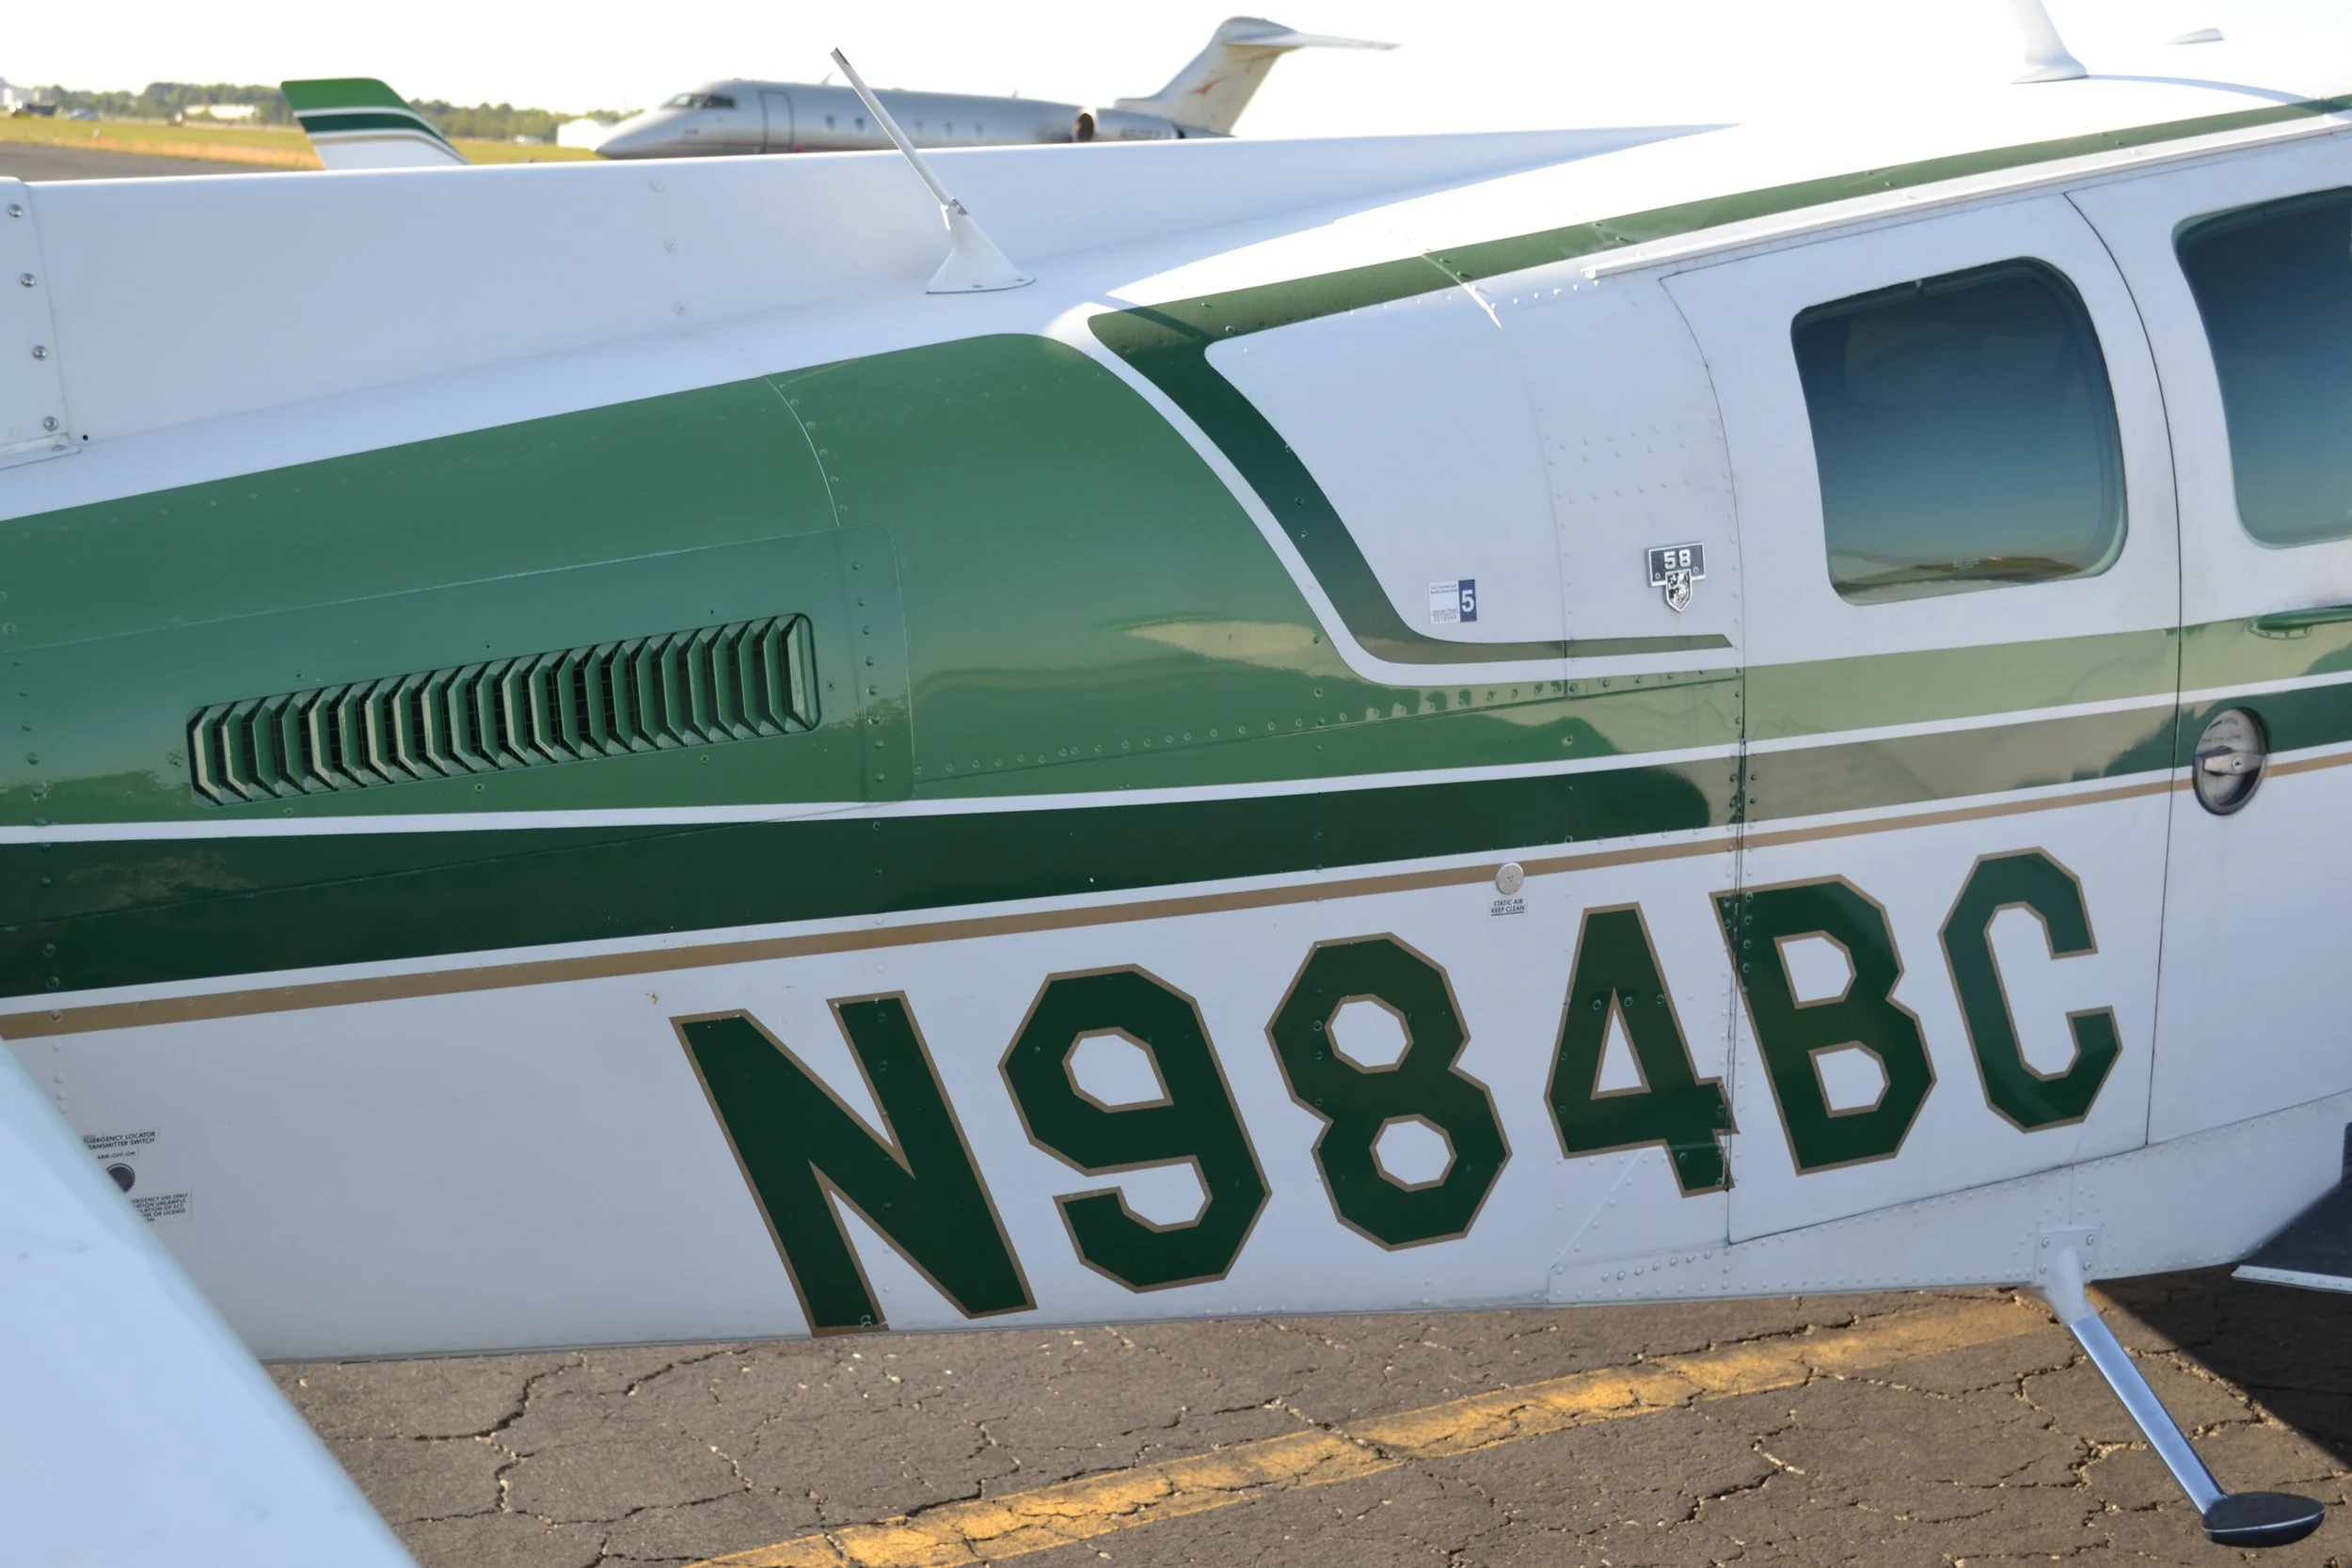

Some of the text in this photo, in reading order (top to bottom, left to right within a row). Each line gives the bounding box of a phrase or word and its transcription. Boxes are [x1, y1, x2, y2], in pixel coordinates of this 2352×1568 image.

[1663, 549, 1691, 570] 58
[1461, 589, 1474, 612] 5
[669, 847, 2123, 1337] N984BC
[125, 1132, 155, 1140] LOCATOR
[87, 1141, 129, 1150] RANSMITTER
[163, 1208, 186, 1216] LICENSE
